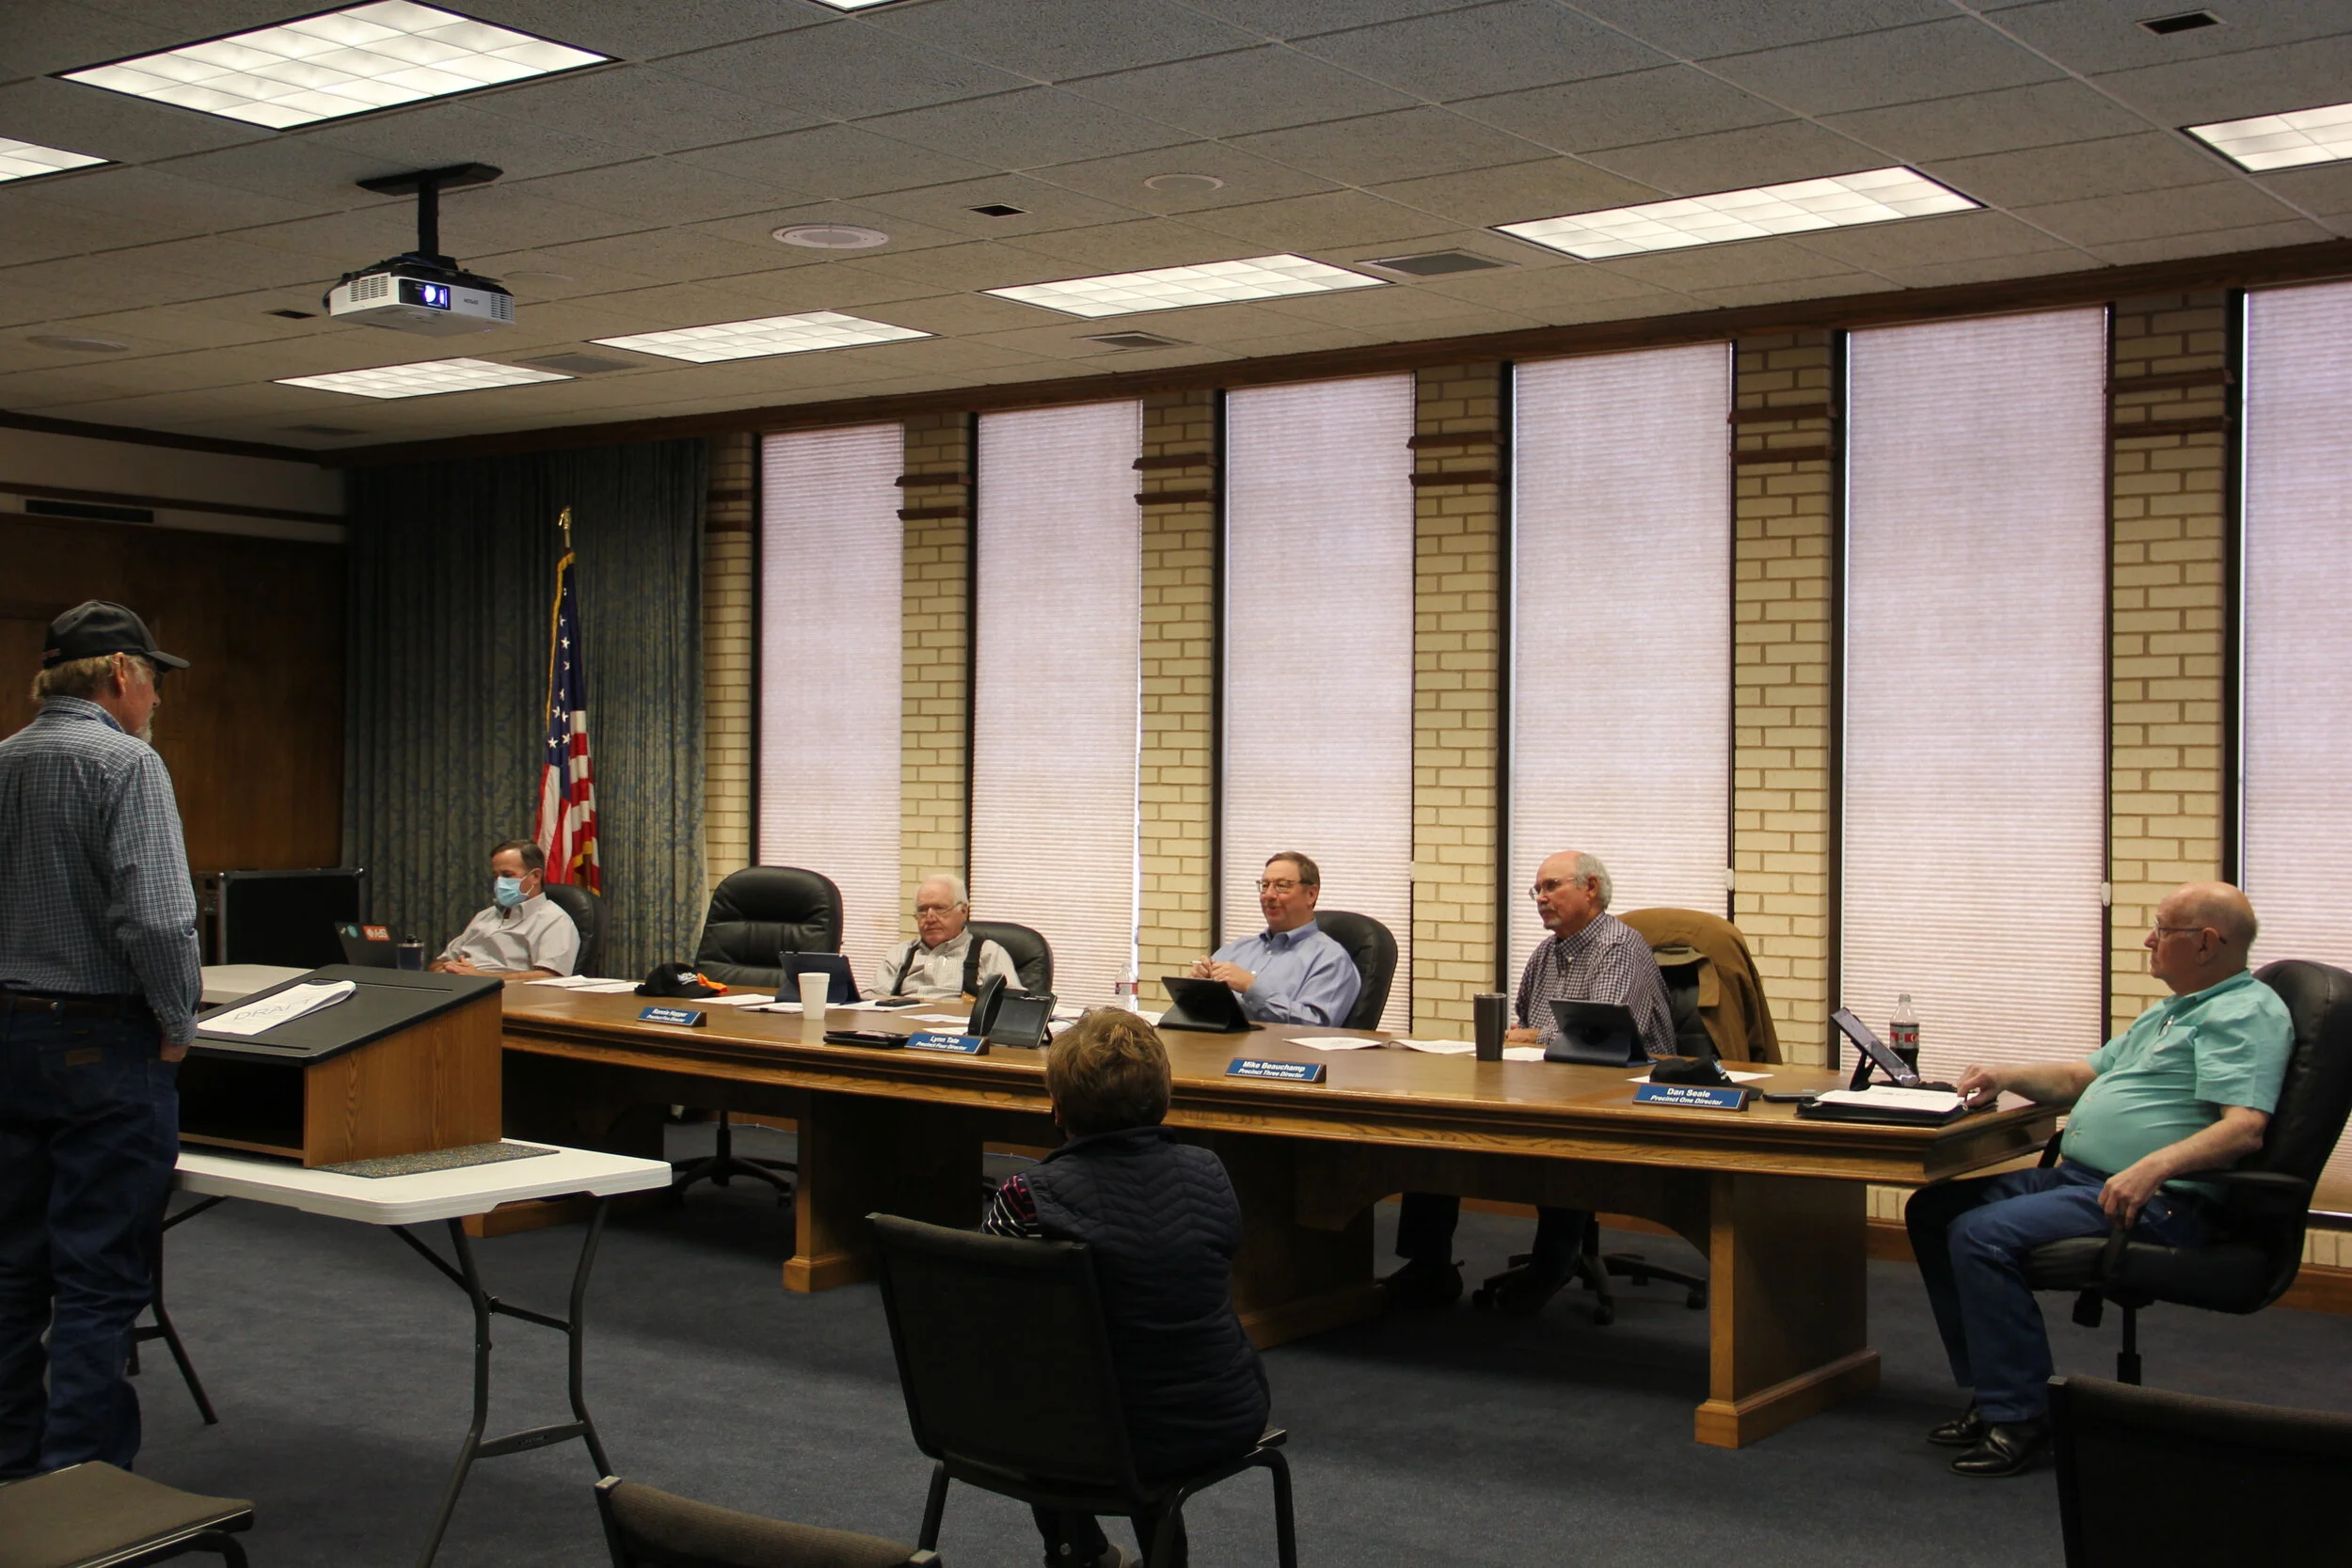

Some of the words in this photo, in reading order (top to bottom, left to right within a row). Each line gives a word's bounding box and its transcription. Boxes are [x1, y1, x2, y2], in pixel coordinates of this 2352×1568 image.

[233, 997, 313, 1021] DRAFT
[1261, 1062, 1306, 1072] Beauchamp
[1666, 1087, 1685, 1096] Dan
[1686, 1089, 1711, 1098] Seale
